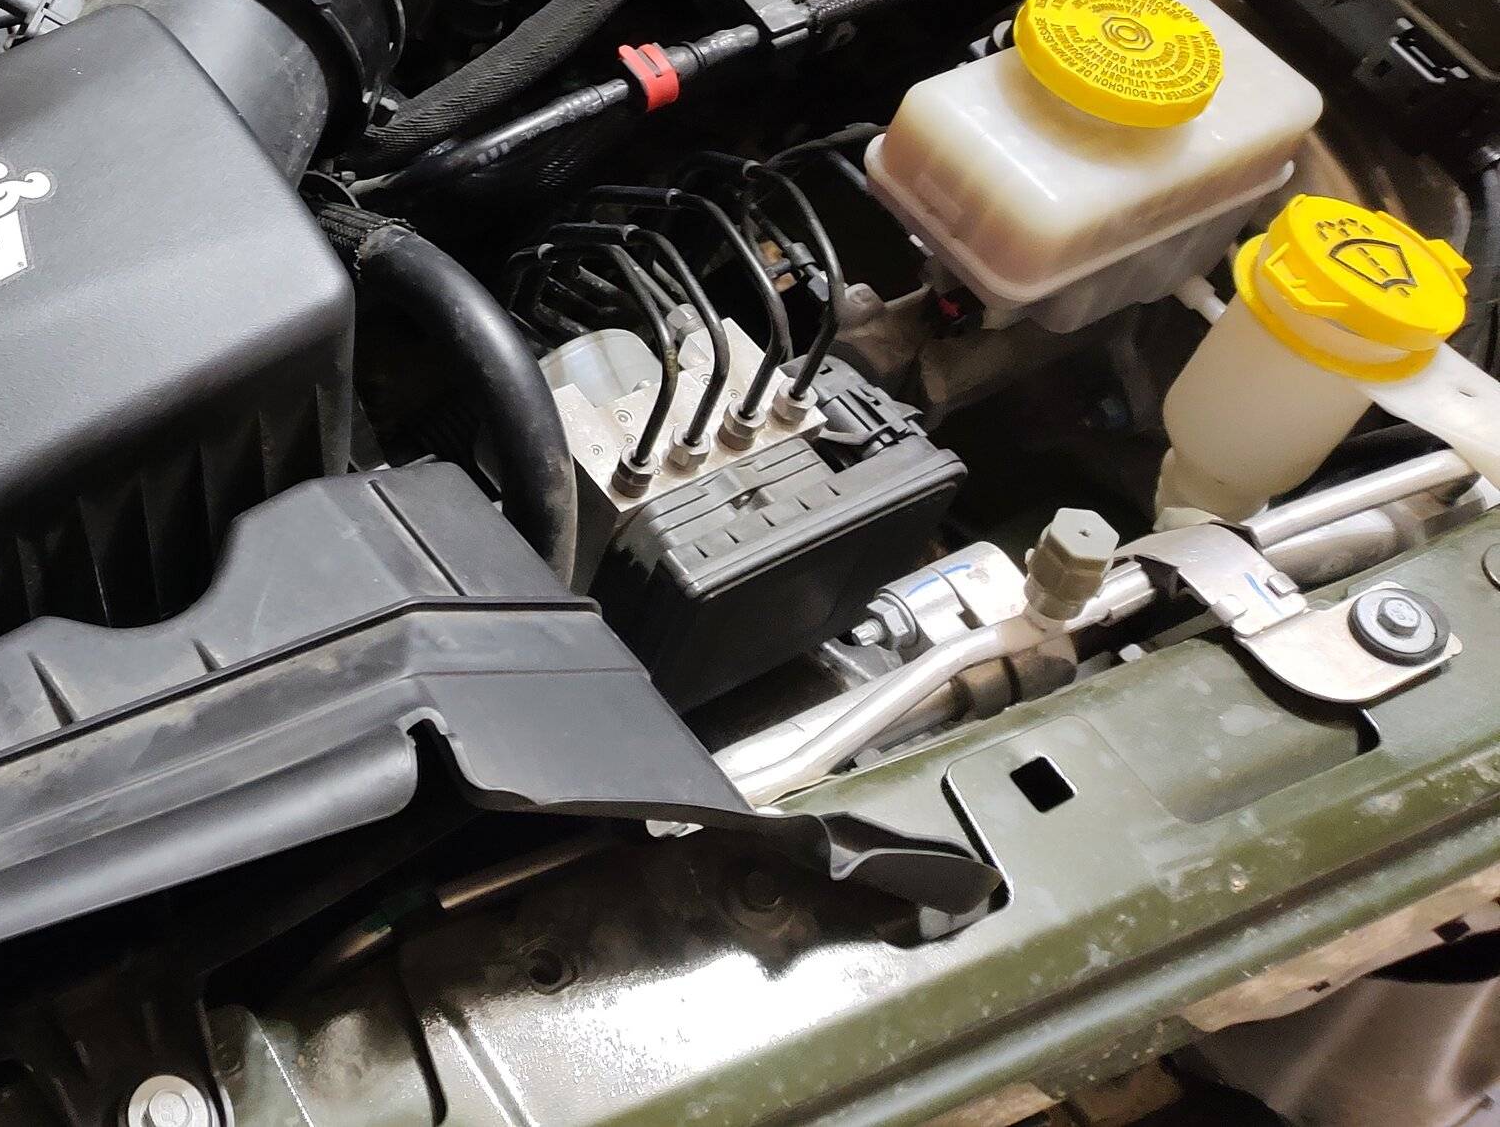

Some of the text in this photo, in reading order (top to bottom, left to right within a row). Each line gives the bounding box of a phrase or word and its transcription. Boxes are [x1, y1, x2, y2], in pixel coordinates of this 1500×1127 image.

[1175, 5, 1200, 22] DOT
[1074, 65, 1093, 78] DE
[1091, 73, 1149, 100] BOUCHON
[1148, 91, 1165, 101] LE
